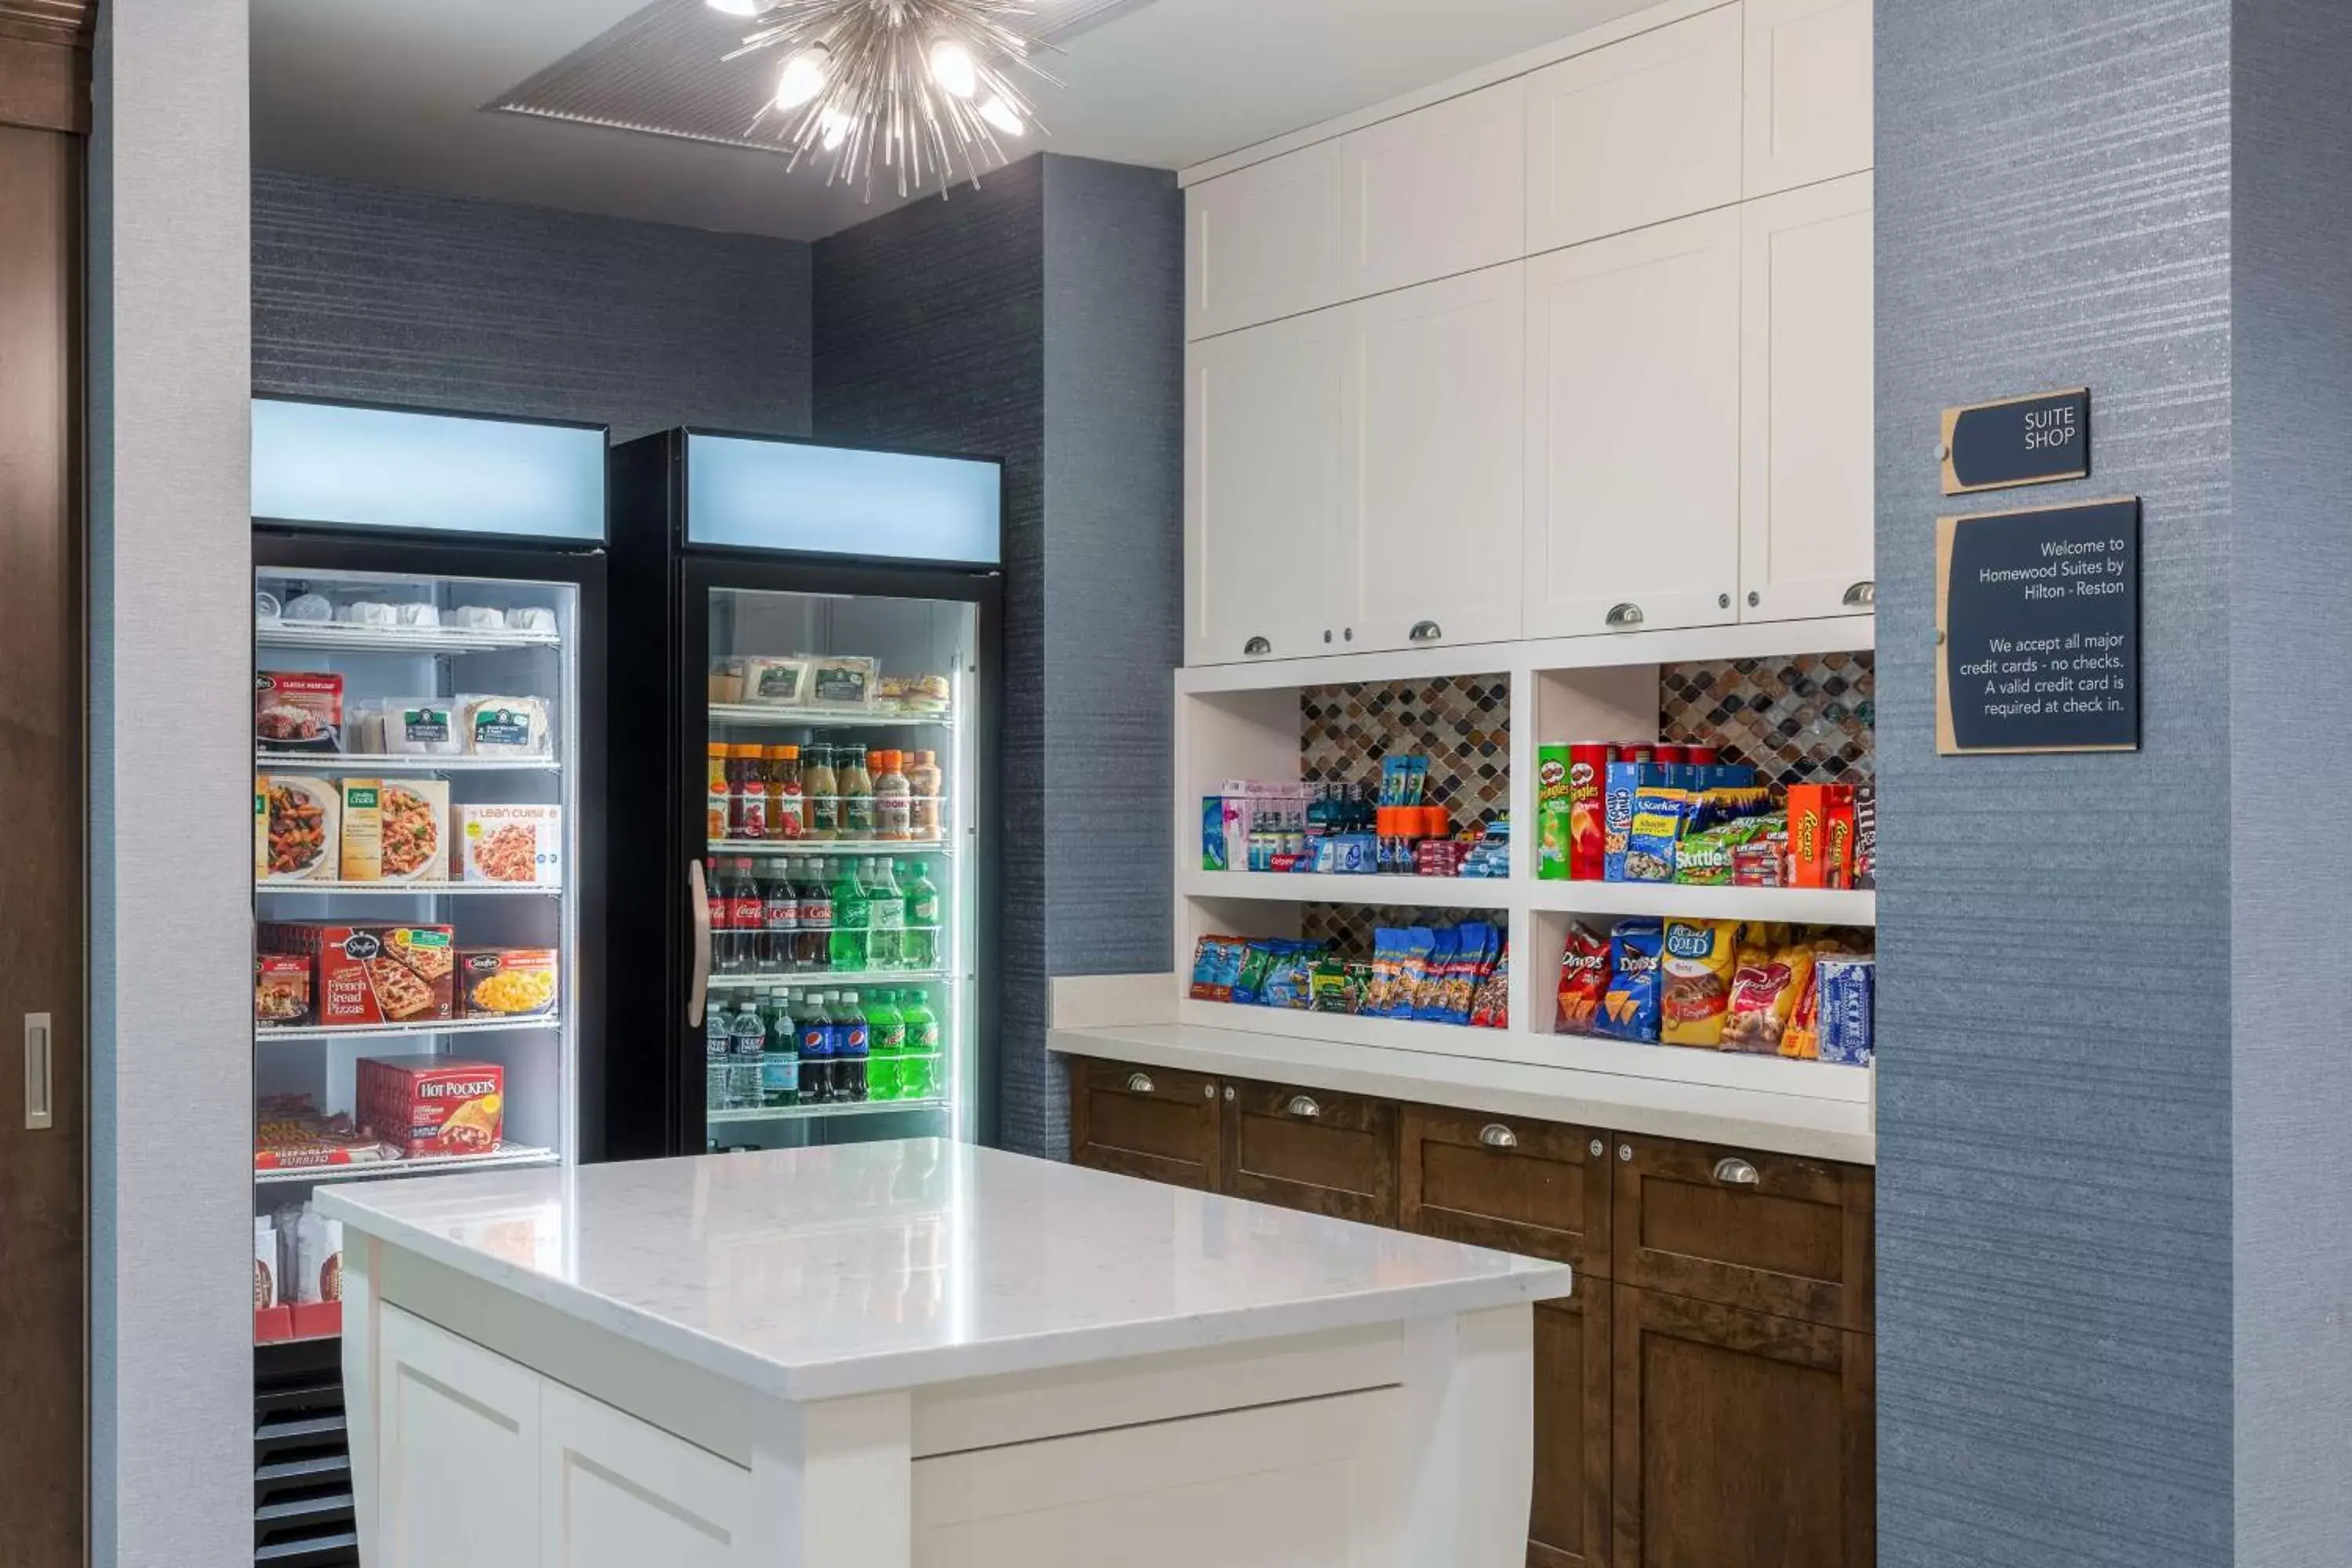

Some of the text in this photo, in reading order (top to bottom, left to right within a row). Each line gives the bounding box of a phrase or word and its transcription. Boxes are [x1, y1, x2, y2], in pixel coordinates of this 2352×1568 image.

[2026, 407, 2074, 432] SUITE
[2026, 425, 2074, 449] SHOP
[2042, 539, 2124, 556] Welcome to
[1980, 558, 2124, 584] Homewood Suites by
[2026, 583, 2064, 599] Hilton
[2077, 582, 2123, 595] Reston
[1990, 633, 2124, 655] We accept all major
[1960, 660, 1997, 674] credit
[2002, 658, 2037, 673] cards
[2051, 660, 2068, 670] no
[2073, 654, 2123, 670] checks.
[1985, 675, 2124, 694] A valid credit card is
[1985, 697, 2123, 717] required at check in.
[328, 980, 366, 992] French
[328, 993, 361, 1004] Bread
[326, 1004, 365, 1015] Pizzas
[441, 1004, 449, 1016] 2
[421, 1080, 495, 1098] HOT POCKETS
[279, 1155, 328, 1167] BURRITO
